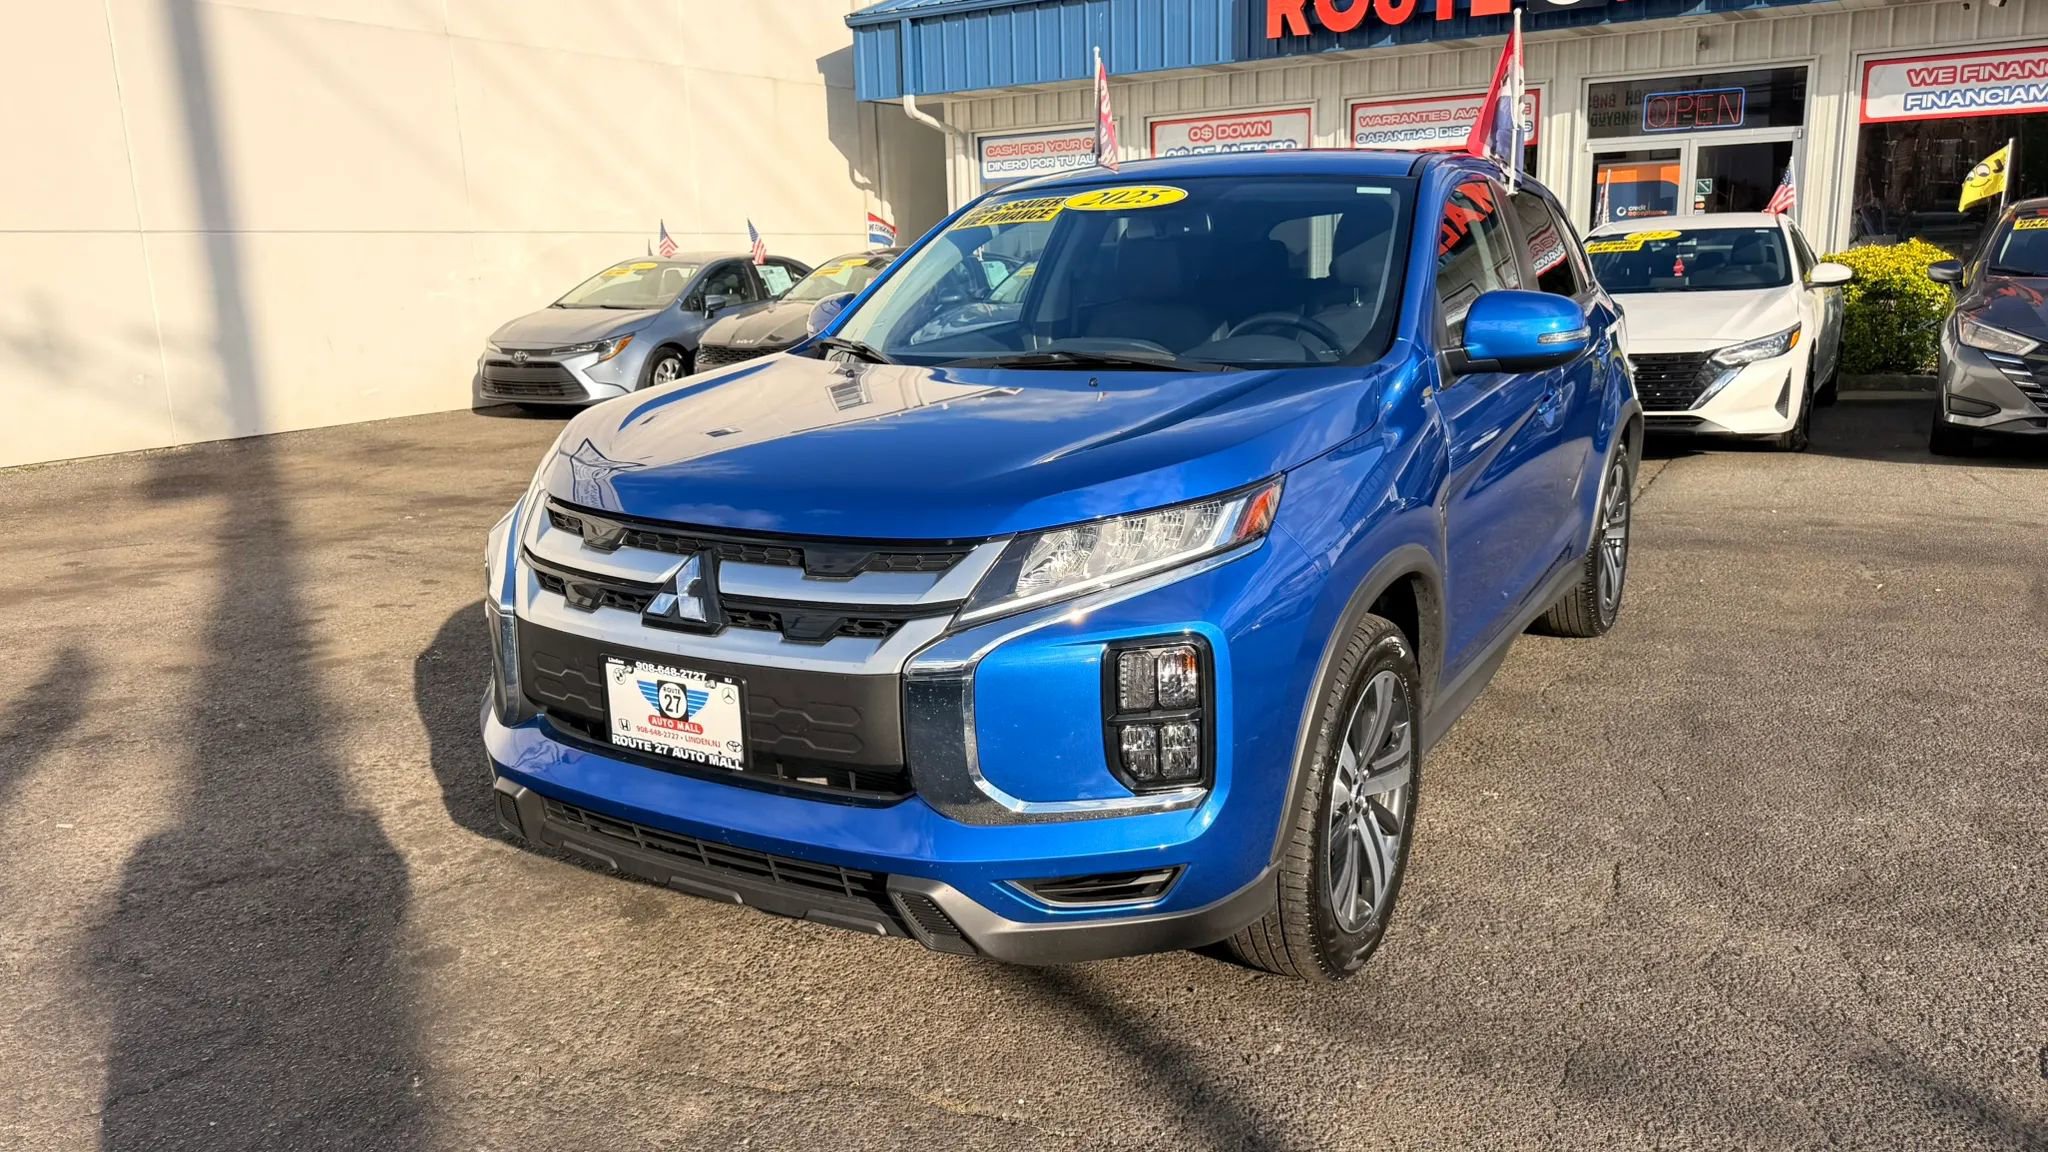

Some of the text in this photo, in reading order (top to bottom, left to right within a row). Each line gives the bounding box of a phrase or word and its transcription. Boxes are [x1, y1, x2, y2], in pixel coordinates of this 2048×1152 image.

[1908, 57, 2048, 87] WE FINAN
[1360, 109, 1450, 128] WARRANTIES
[1647, 93, 1742, 128] OPEN
[1216, 120, 1272, 140] DOWN
[1356, 128, 1437, 145] GARANTIAS
[986, 145, 1018, 157] CASH
[1021, 143, 1043, 154] FOR
[1047, 140, 1080, 152] YOUR
[987, 160, 1027, 172] DINERO
[1030, 158, 1056, 169] POR
[1057, 155, 1074, 167] TU
[1080, 189, 1170, 208] 2025
[979, 206, 1053, 224] FINANCE
[635, 661, 707, 681] 908-648-2727
[663, 686, 681, 695] ROUTE
[664, 693, 682, 714] 27
[636, 725, 679, 740] 908-648-2727
[651, 716, 701, 733] AUTO MALL
[612, 734, 744, 771] ROUTE 27 AUTO MALL
